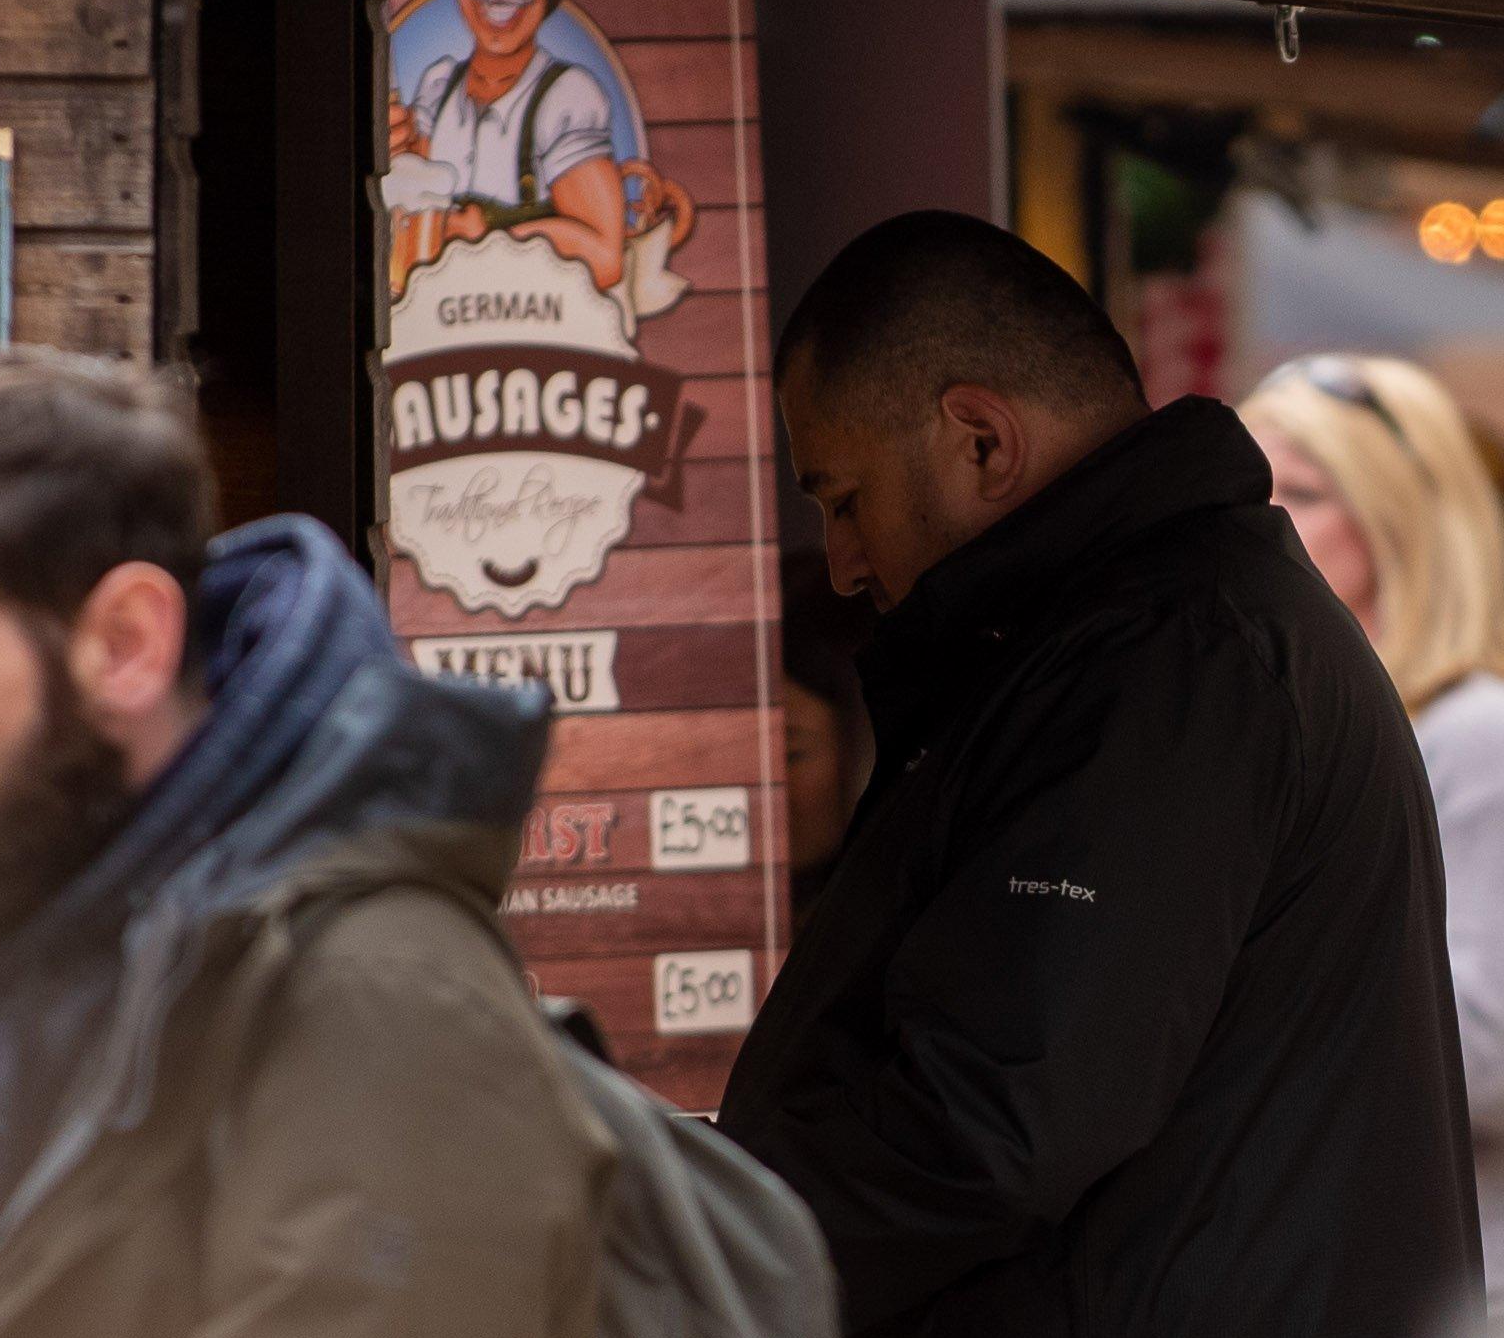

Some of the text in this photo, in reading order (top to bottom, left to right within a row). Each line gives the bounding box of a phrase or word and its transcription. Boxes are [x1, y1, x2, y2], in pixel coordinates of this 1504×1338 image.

[437, 291, 564, 328] GERMAN
[542, 883, 639, 911] SAUSAGE
[1008, 876, 1096, 902] tres-tex
